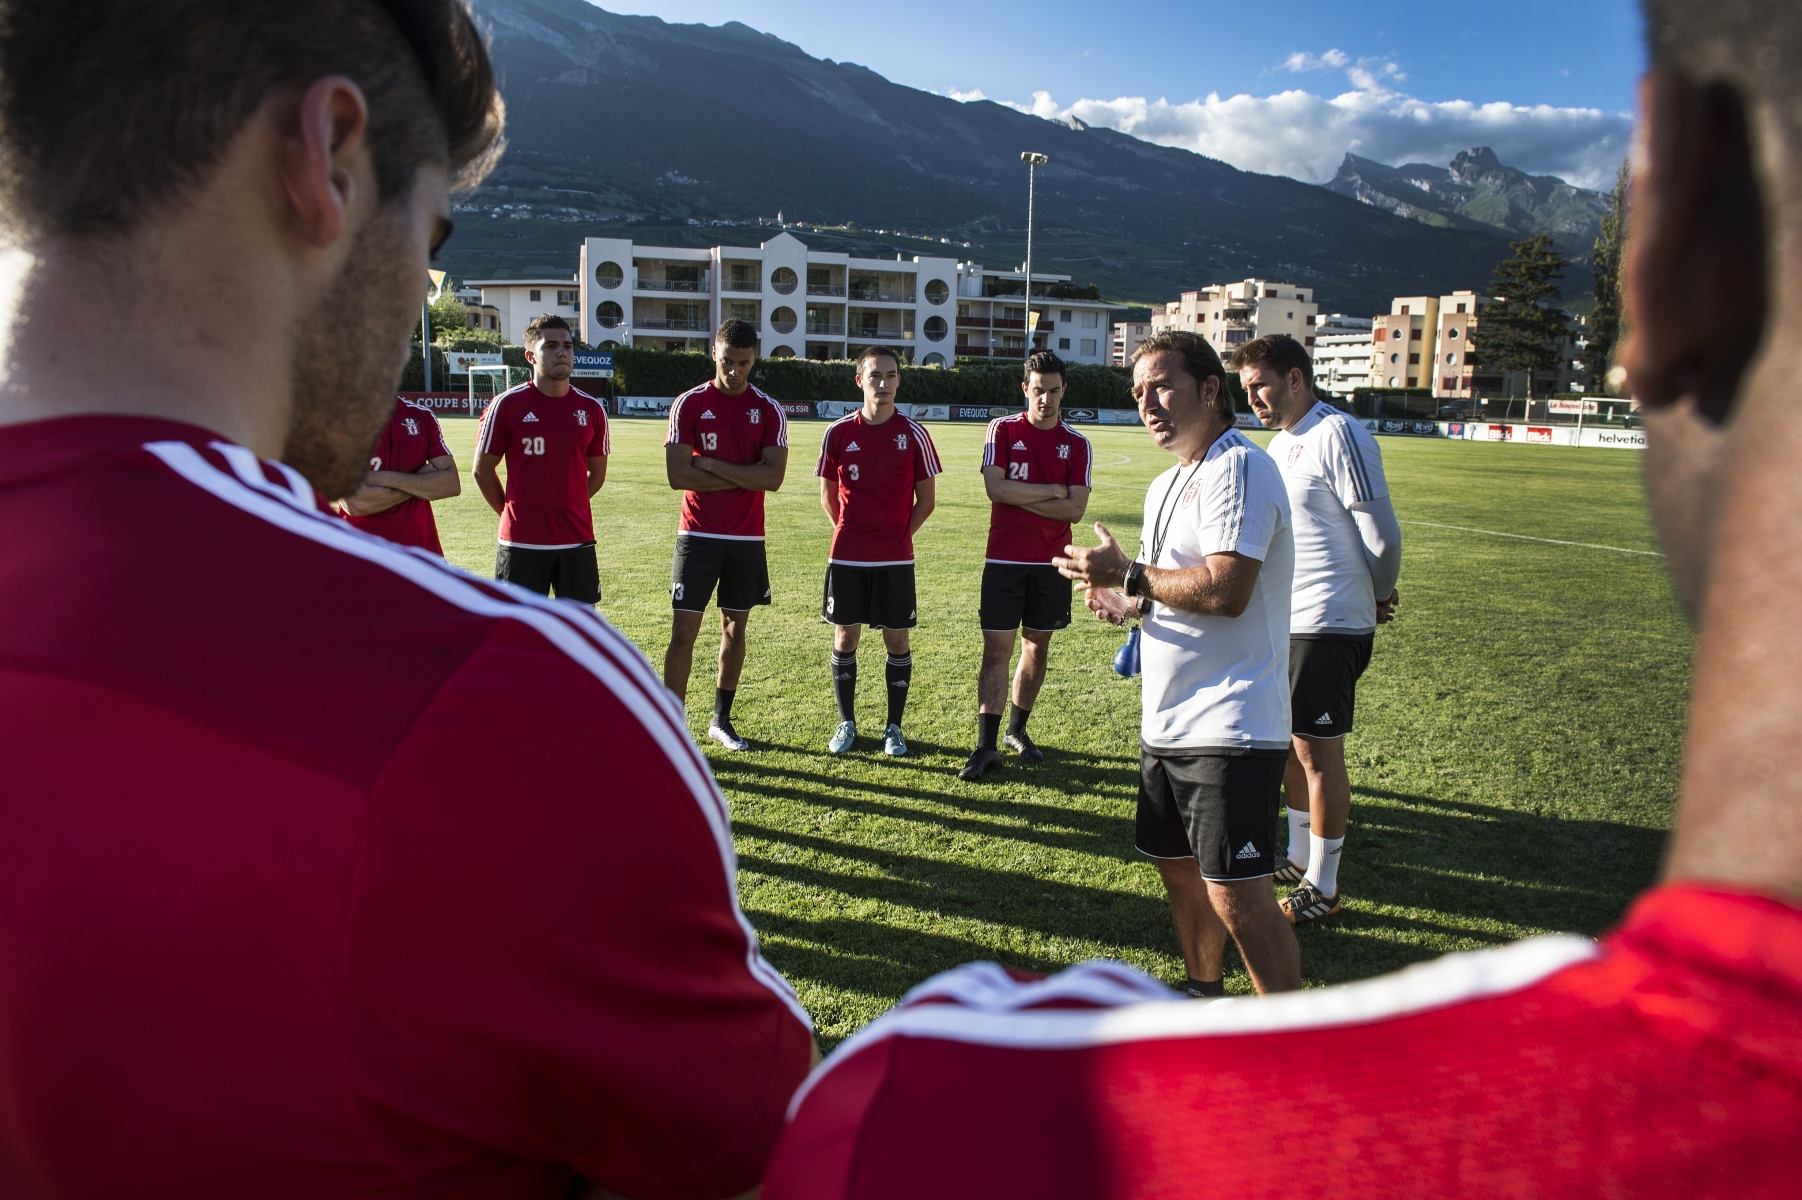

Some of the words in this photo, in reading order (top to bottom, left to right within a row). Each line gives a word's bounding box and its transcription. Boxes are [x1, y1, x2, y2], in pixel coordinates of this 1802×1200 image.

[417, 398, 458, 408] COUPE
[960, 408, 988, 418] EVEQUOZ
[1386, 421, 1403, 430] Nord
[1489, 430, 1512, 440] Blick
[1528, 431, 1551, 442] Blick
[1599, 433, 1645, 445] helvetia
[521, 436, 545, 455] 20
[701, 433, 718, 450] 13
[848, 464, 859, 480] 3
[1009, 462, 1029, 480] 24
[827, 596, 834, 615] 3
[1236, 851, 1260, 859] adidas
